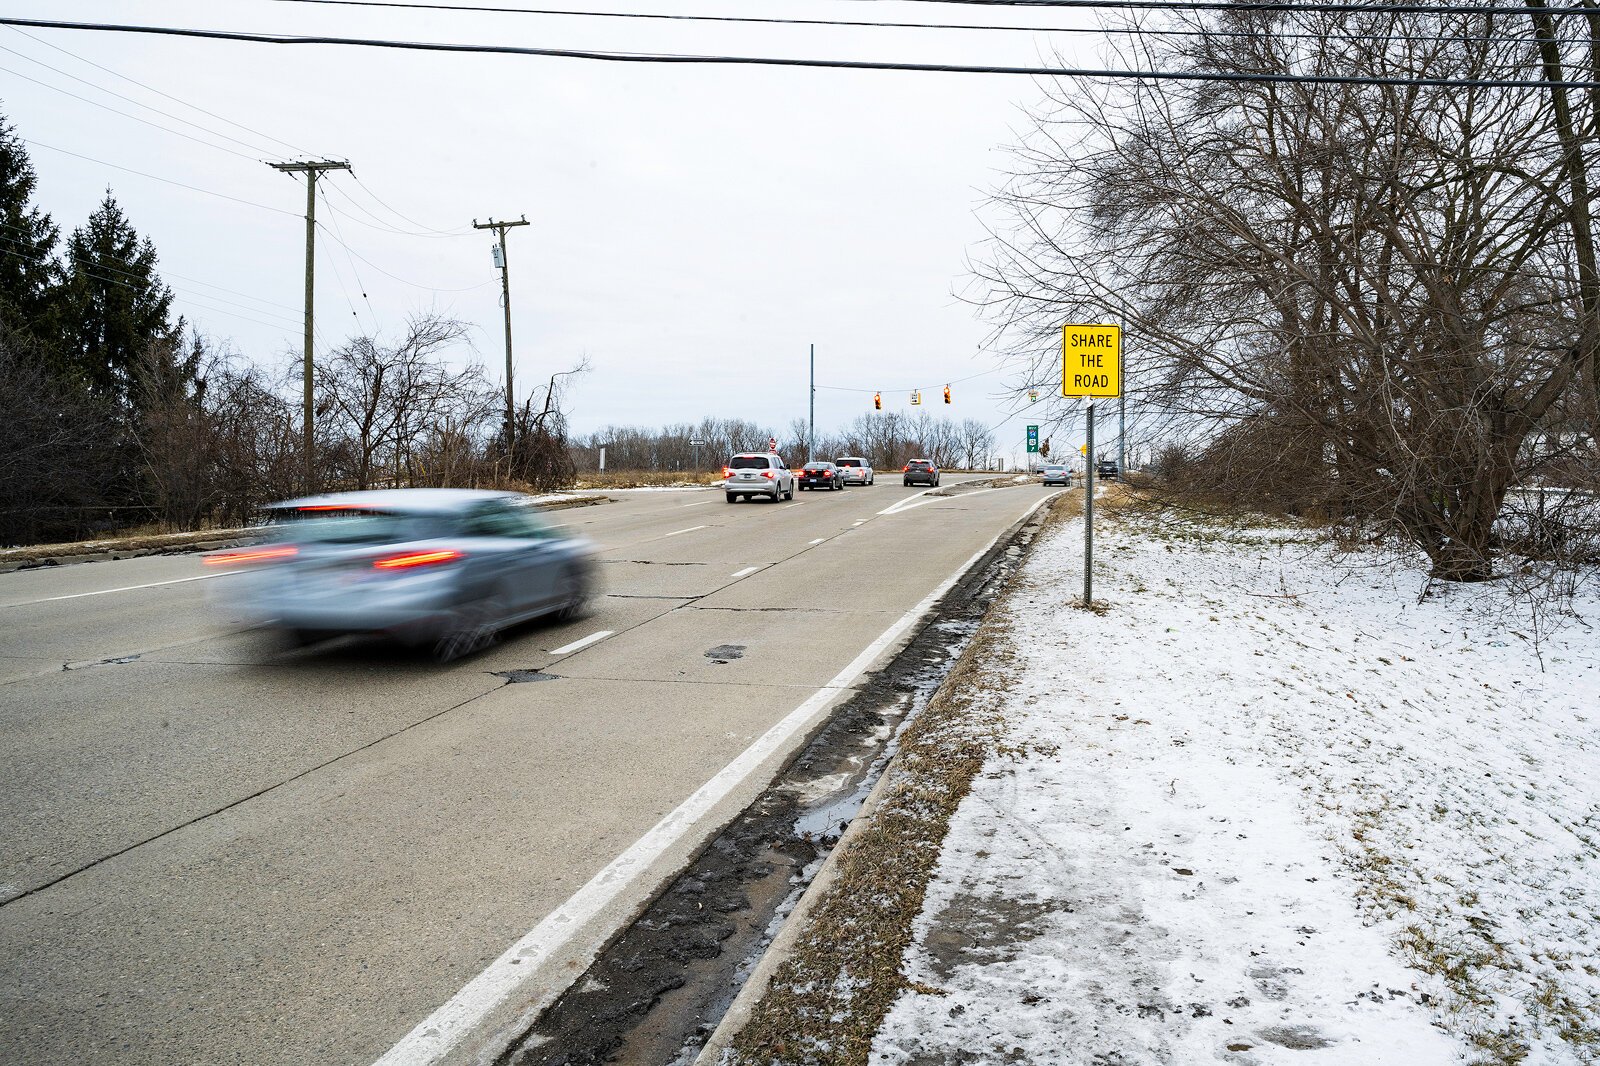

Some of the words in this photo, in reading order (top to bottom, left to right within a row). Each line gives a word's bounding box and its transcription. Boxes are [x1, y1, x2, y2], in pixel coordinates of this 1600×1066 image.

[1071, 334, 1112, 347] SHARE
[1080, 354, 1103, 367] THE
[1074, 374, 1108, 387] ROAD
